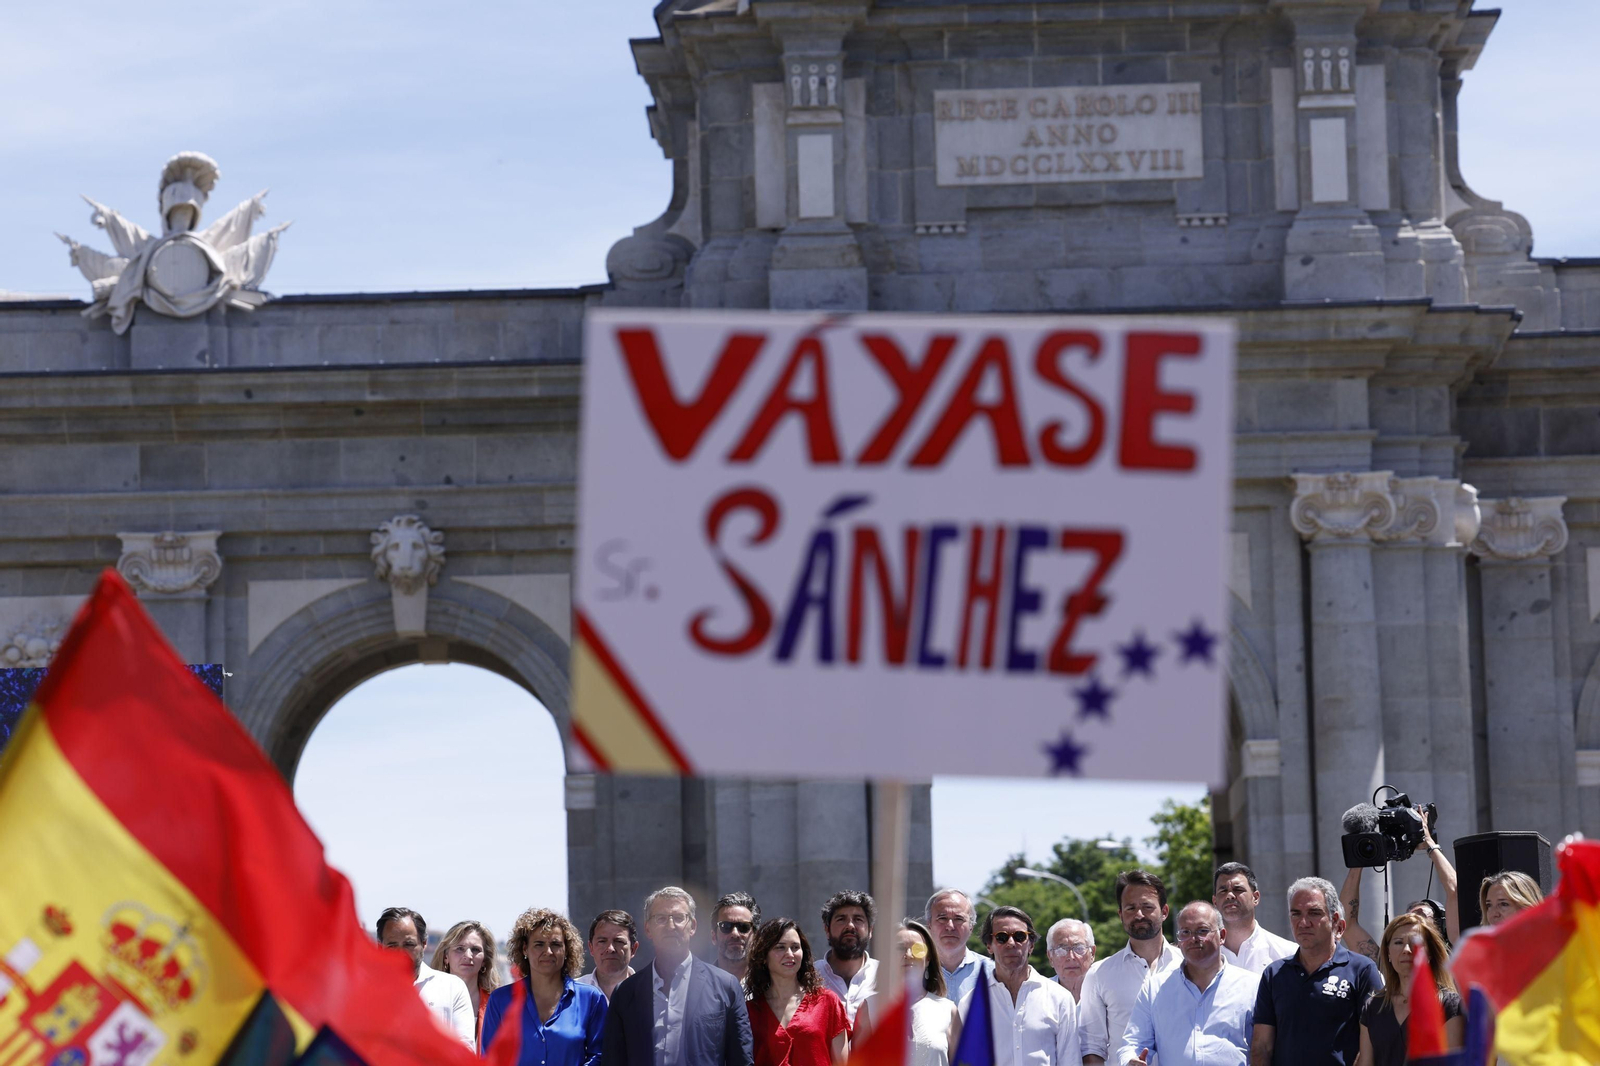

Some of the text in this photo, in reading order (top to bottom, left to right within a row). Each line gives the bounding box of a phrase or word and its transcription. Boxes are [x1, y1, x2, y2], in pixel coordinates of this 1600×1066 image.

[935, 91, 1201, 121] REGE CAROLO III
[1021, 123, 1119, 147] ANNO
[955, 149, 1185, 177] MDCCLXXVIII
[612, 314, 1204, 473] VÁYASE
[593, 484, 1128, 676] Sr. SÁNCHEZ
